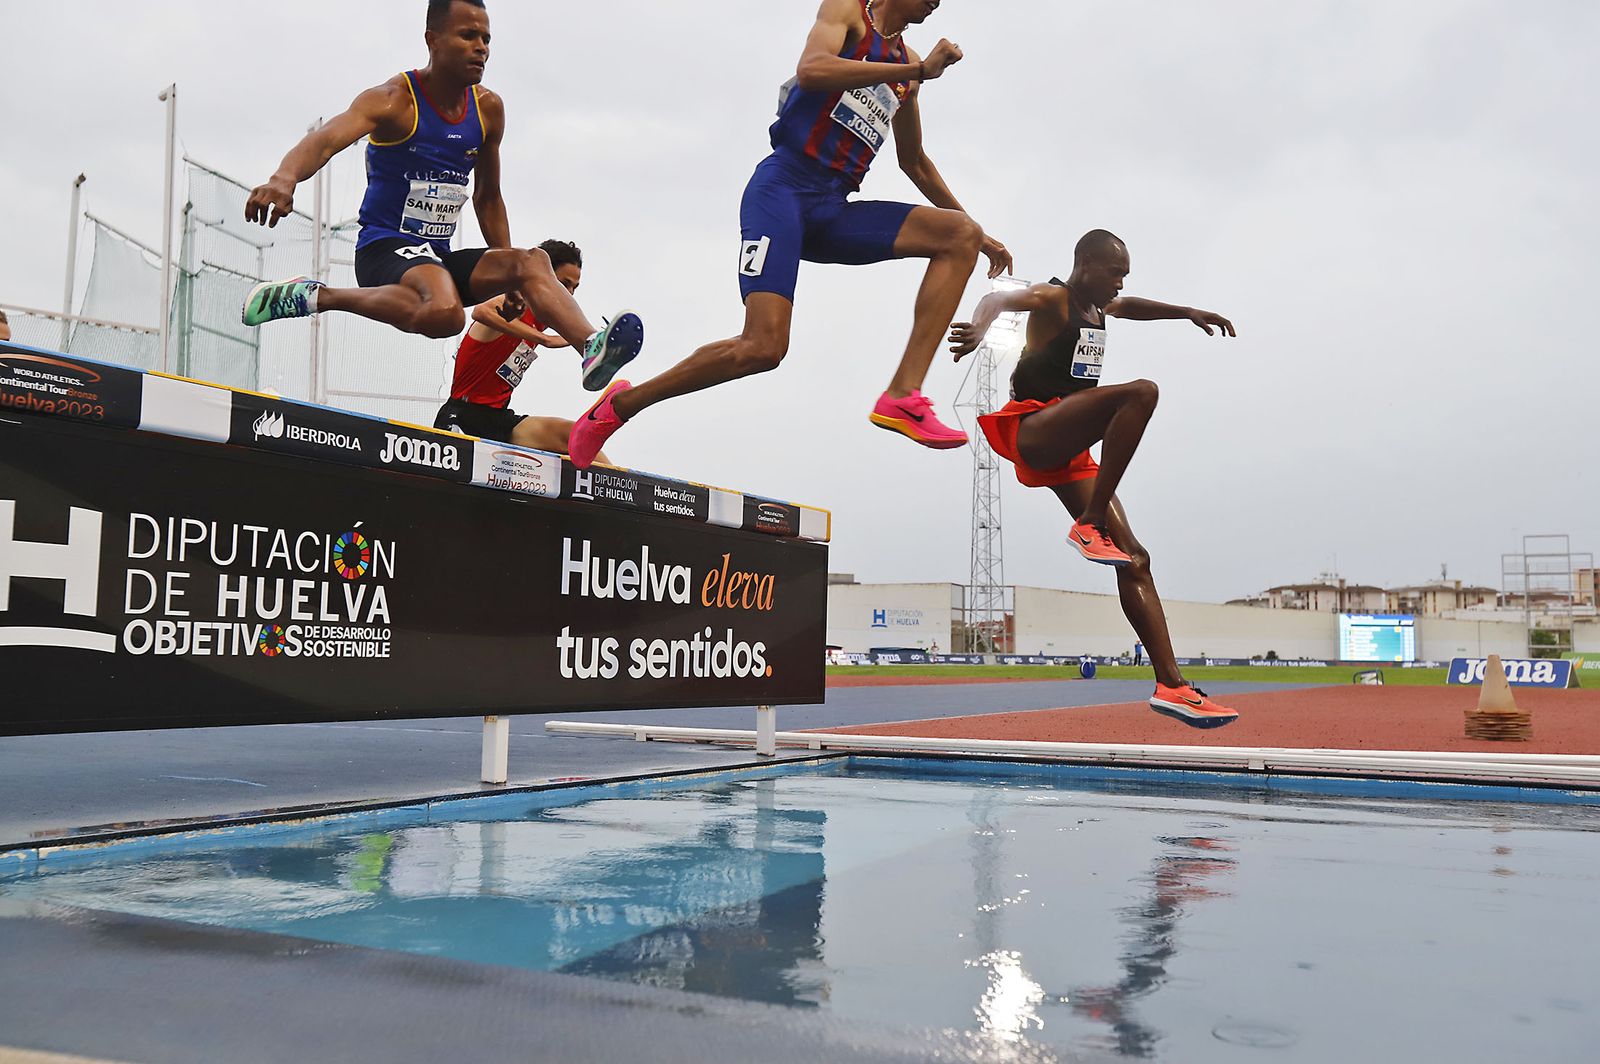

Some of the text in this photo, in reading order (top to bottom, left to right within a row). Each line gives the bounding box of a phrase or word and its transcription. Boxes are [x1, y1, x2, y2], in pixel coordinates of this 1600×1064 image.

[407, 198, 433, 212] SAN
[418, 223, 451, 235] Joma
[0, 376, 47, 392] ontinental
[13, 368, 80, 385] WORLD ATHLETICS
[0, 389, 104, 420] uelva2023
[286, 424, 361, 451] IBERDROLA
[595, 473, 638, 490] DIPUTACIÓN
[595, 486, 634, 502] DE HUELVA
[654, 486, 678, 500] Huelva
[654, 501, 695, 517] tus sentidos.
[128, 513, 396, 580] DIPUTACIÓN
[561, 537, 775, 611] Huelva eleva
[124, 569, 391, 624] DE HUELVA
[123, 619, 391, 657] OBJETIVOS DE DESARROLLO
[302, 640, 391, 658] SOSTENIBLE
[557, 625, 772, 679] tus sentidos.
